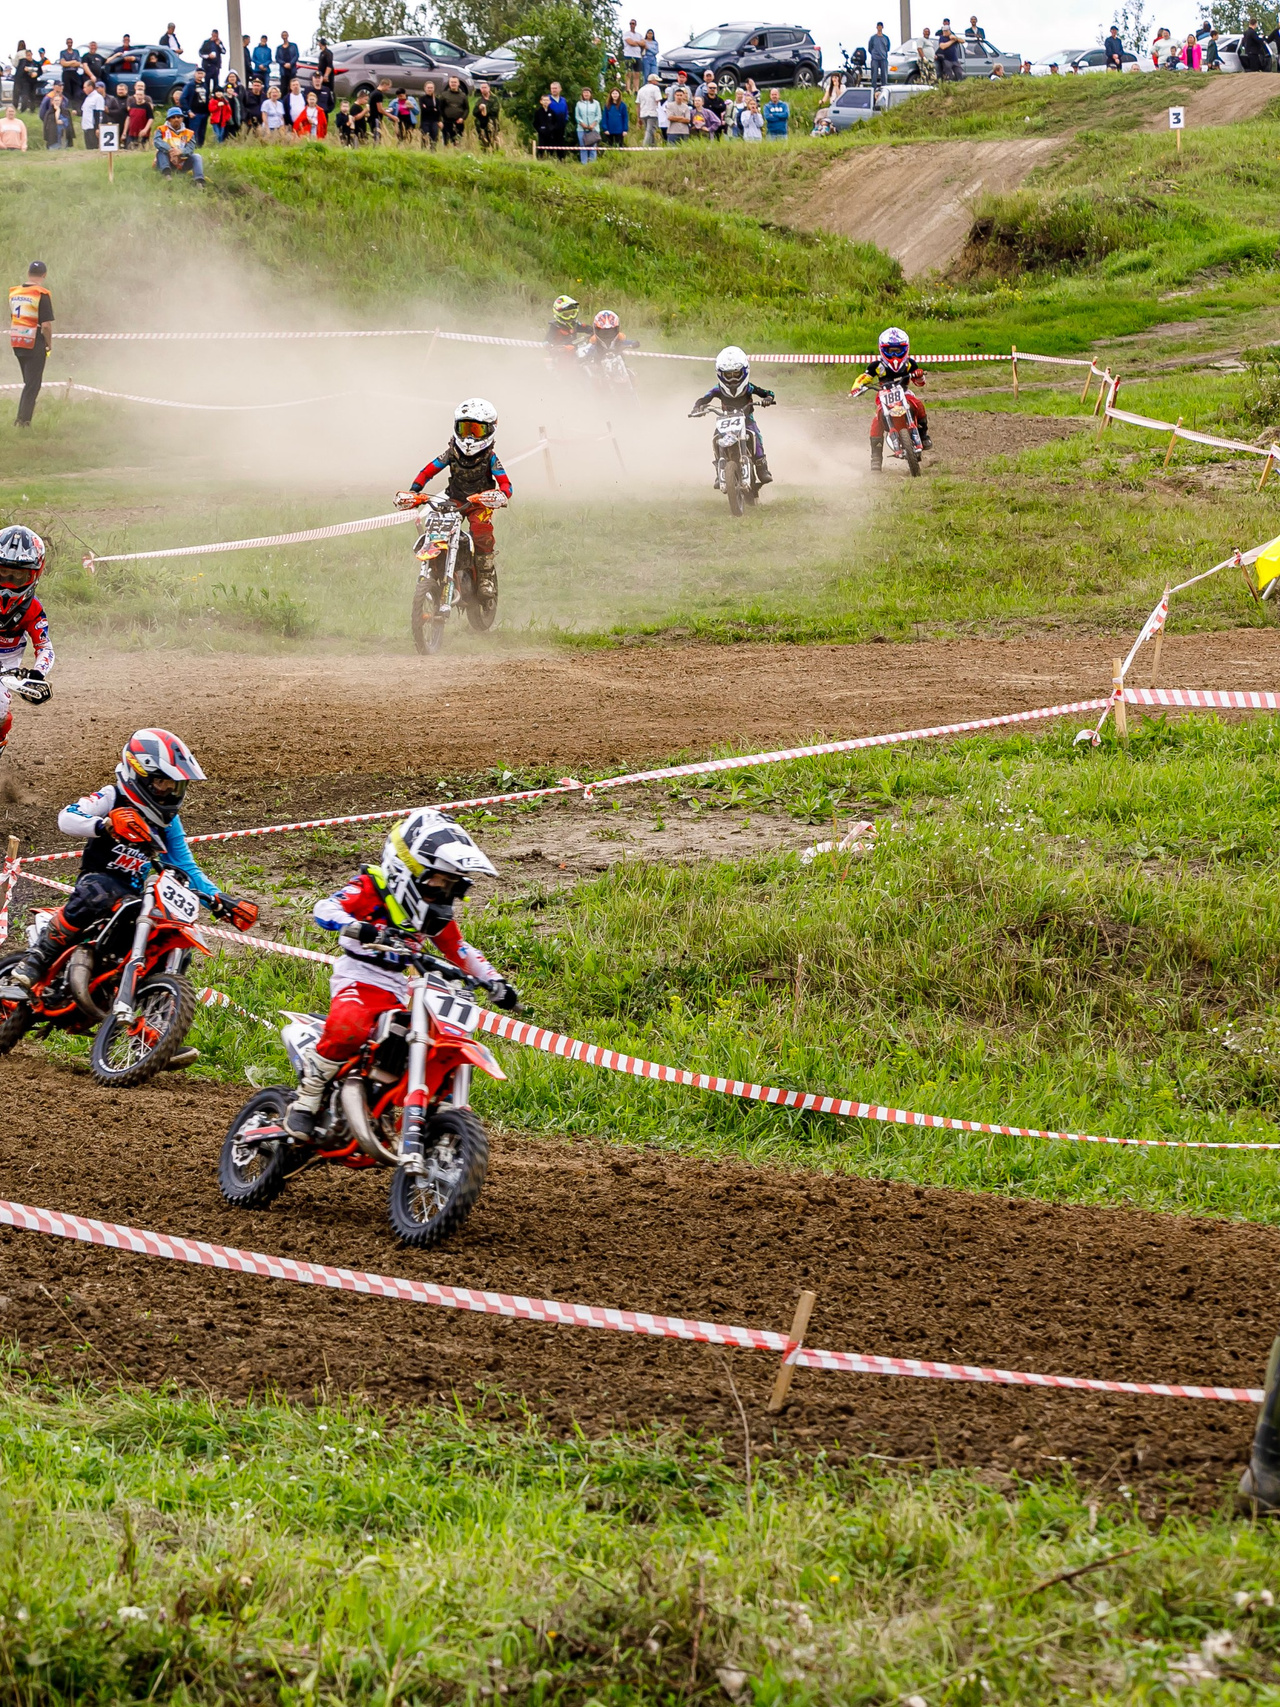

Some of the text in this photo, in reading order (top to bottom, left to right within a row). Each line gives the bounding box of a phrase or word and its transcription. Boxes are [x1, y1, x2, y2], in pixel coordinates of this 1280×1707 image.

[1172, 112, 1182, 124] 3
[103, 131, 115, 146] 2
[14, 305, 21, 318] 1
[884, 390, 901, 405] 188
[162, 885, 196, 918] 333
[436, 995, 473, 1025] 11
